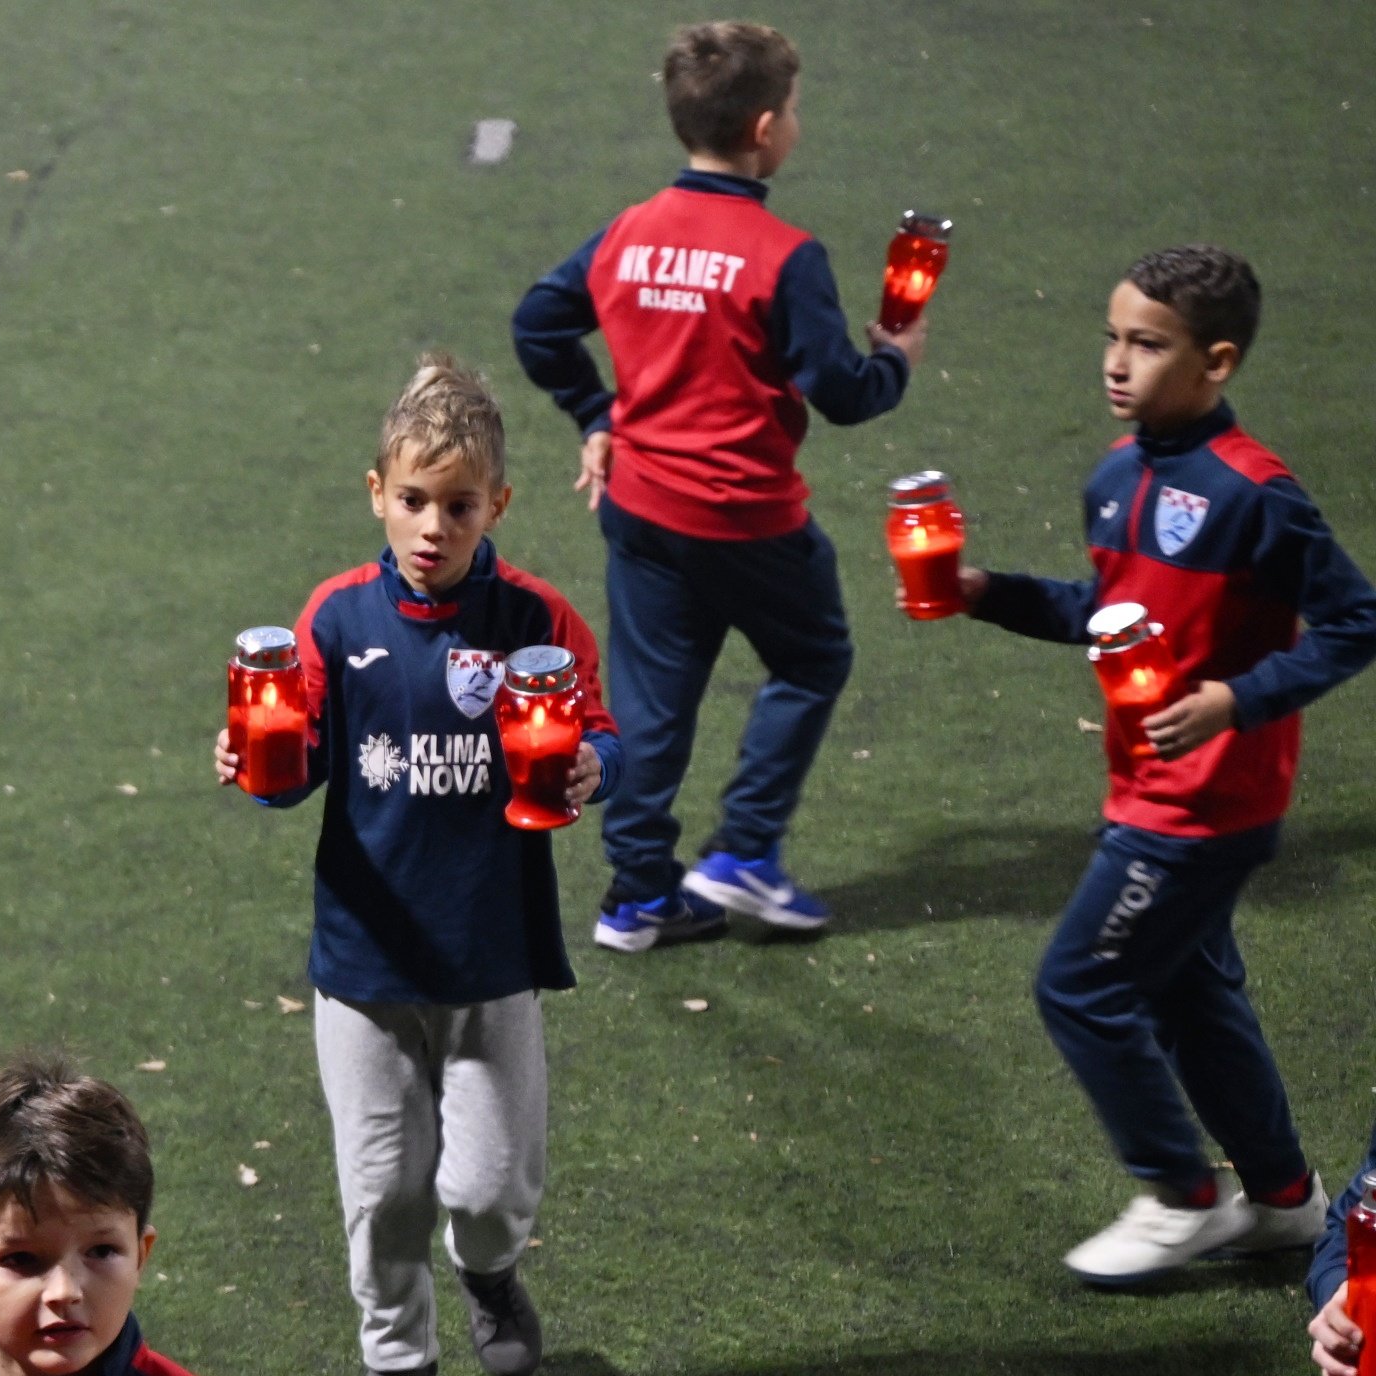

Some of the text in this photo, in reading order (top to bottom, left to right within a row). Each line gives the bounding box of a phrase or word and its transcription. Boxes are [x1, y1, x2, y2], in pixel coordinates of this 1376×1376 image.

[654, 246, 745, 293] ZAMET
[638, 287, 706, 313] RIJEKA
[410, 733, 492, 764] KLIMA
[409, 764, 491, 795] NOVA
